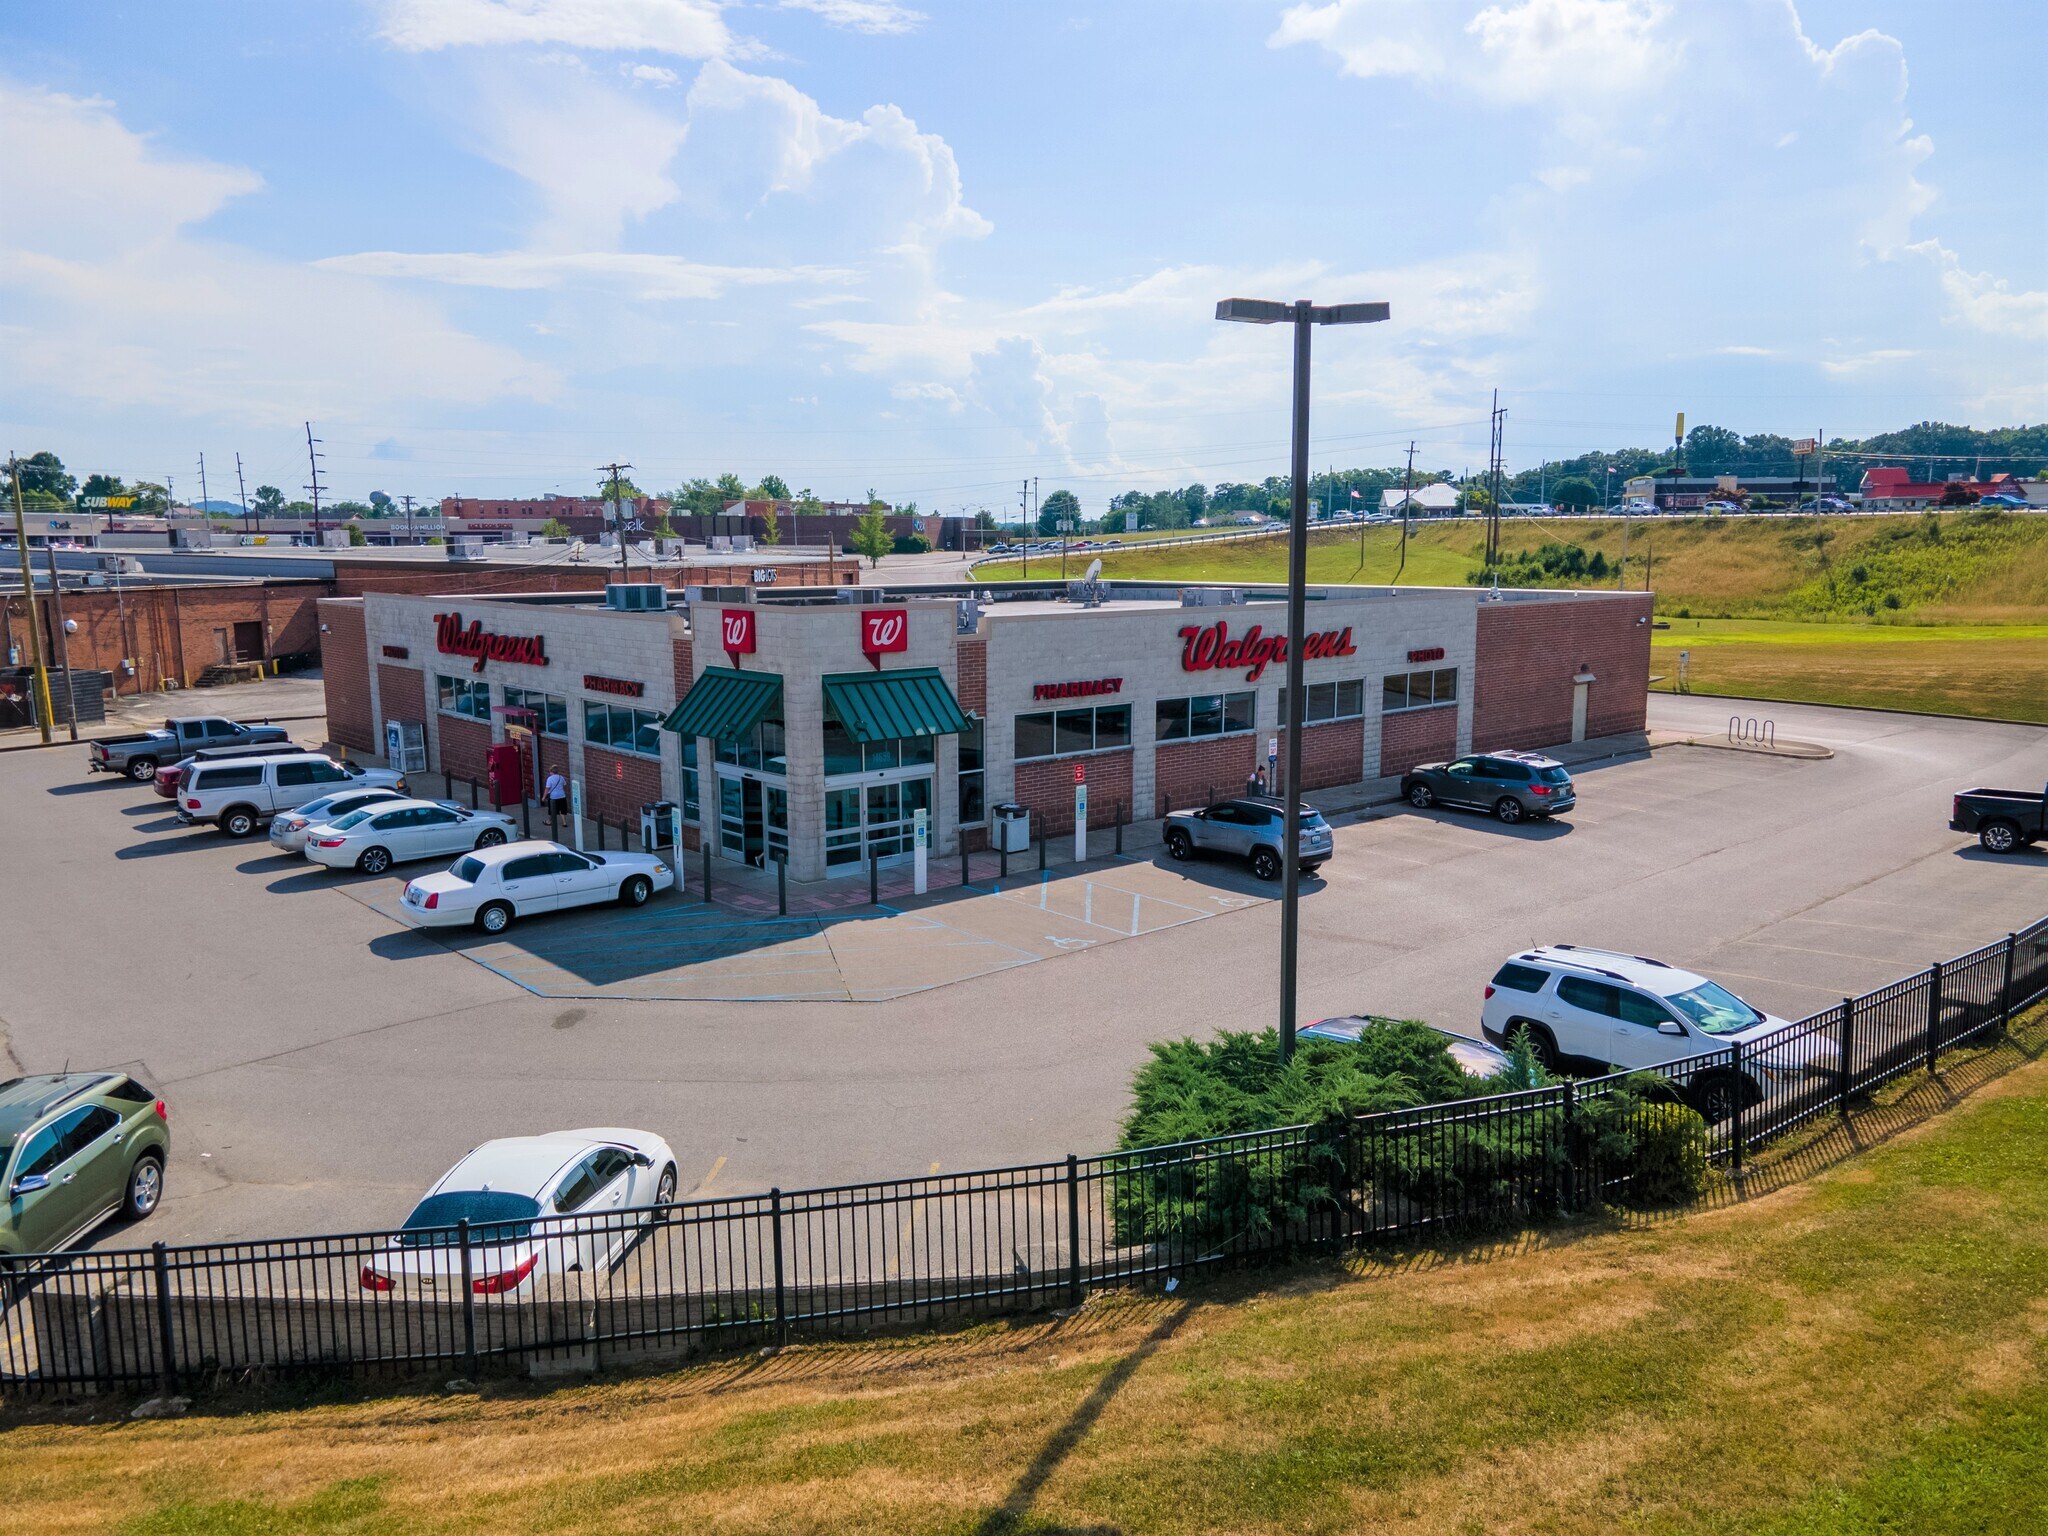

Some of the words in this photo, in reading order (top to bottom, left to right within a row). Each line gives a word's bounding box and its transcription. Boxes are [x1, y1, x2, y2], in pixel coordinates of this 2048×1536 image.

[81, 497, 137, 509] SUBWAY
[753, 569, 765, 583] BIG
[433, 612, 549, 672] Walgreens
[724, 616, 747, 645] W
[869, 615, 902, 646] W
[1179, 620, 1357, 682] Walgrens
[1408, 647, 1445, 663] PHOTO
[583, 674, 644, 697] PHARMACY
[1033, 677, 1124, 700] PHARMACY
